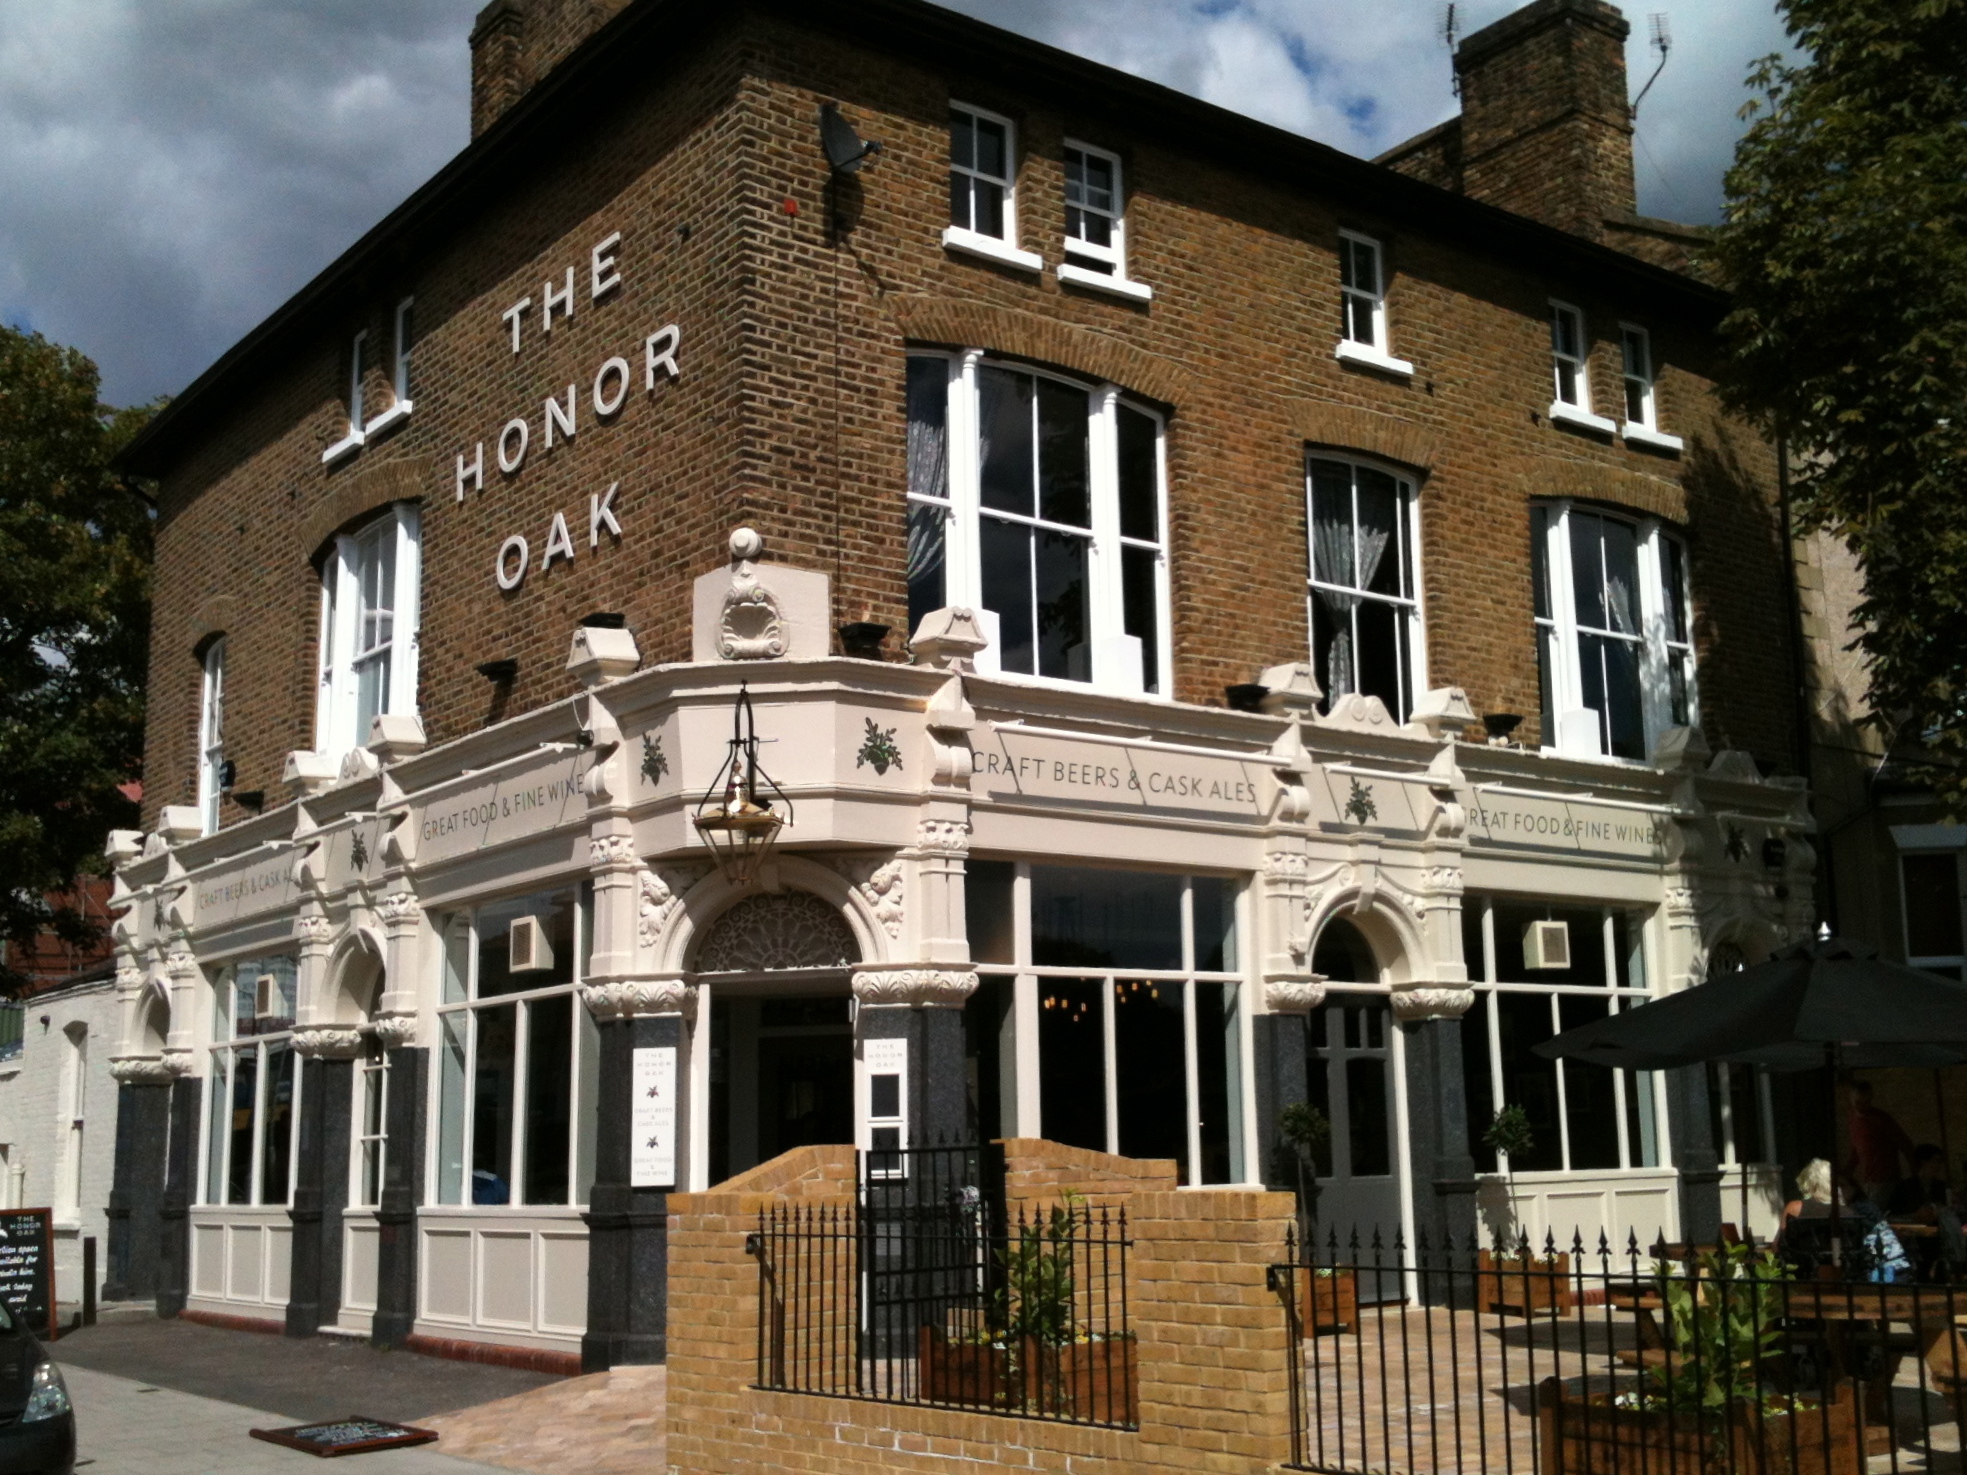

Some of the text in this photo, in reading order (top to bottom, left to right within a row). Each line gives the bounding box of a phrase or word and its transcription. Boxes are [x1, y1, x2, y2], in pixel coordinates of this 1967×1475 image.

[502, 231, 620, 353] THE
[456, 323, 680, 501] HONOR
[497, 481, 622, 590] OAK
[423, 773, 584, 841] GREAT FOOD & FINE WINE
[972, 752, 1256, 803] CRAFT BEERS & CASK ALES
[1514, 813, 1560, 835] FOOD
[1563, 819, 1573, 836] &
[1577, 820, 1610, 840] FINE
[199, 888, 223, 910] CRAFT
[225, 879, 249, 902] BEERS
[251, 877, 257, 894] &
[259, 871, 281, 891] CASK
